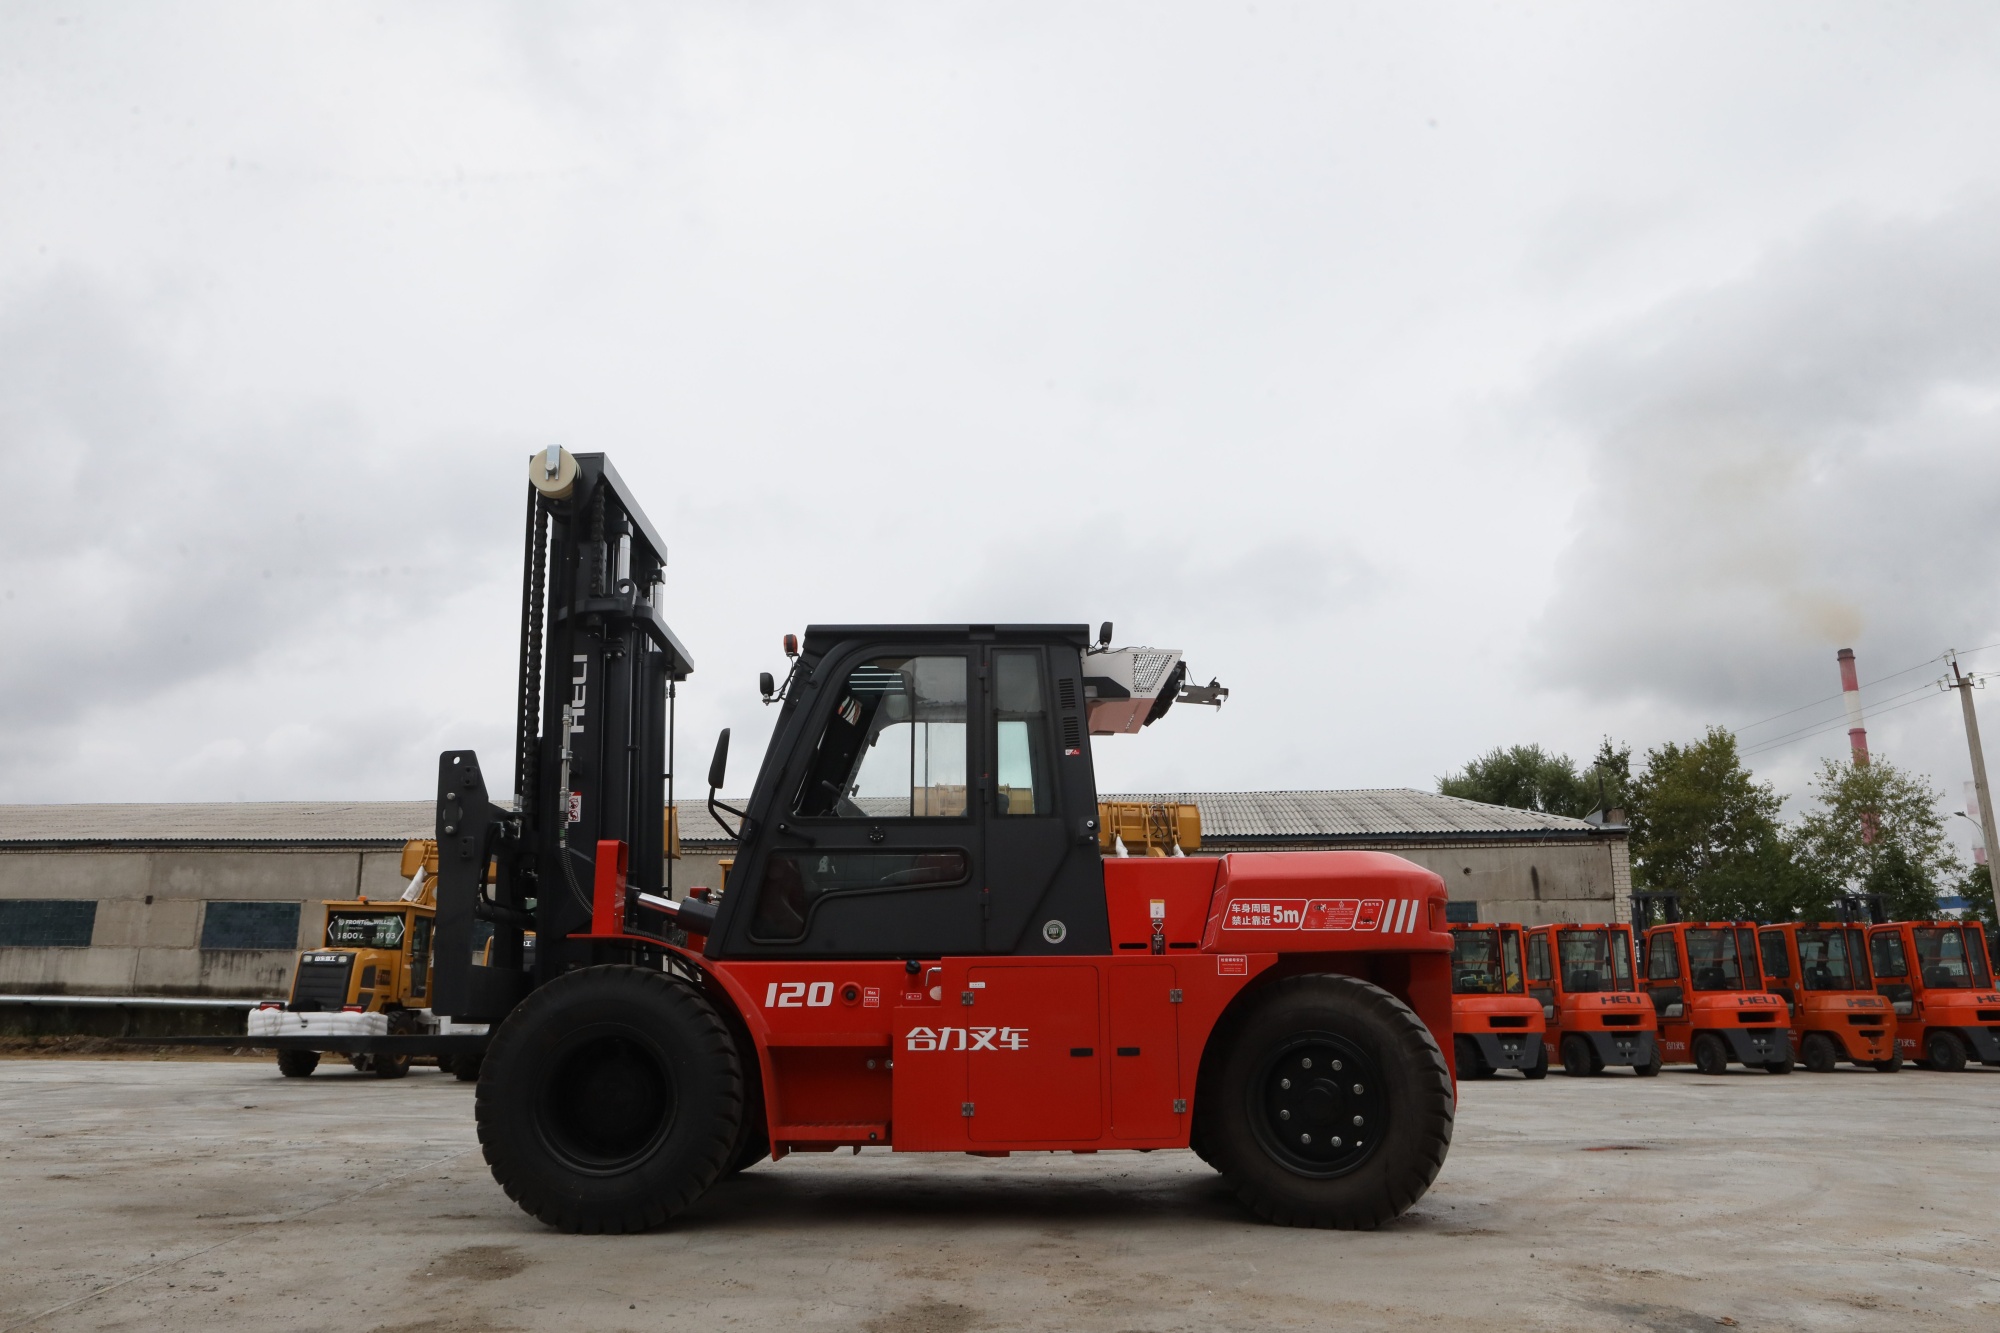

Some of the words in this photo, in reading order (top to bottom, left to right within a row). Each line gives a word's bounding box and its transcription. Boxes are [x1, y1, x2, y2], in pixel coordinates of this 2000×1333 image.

[571, 655, 588, 733] HELI
[1231, 903, 1270, 913] 车身周围
[1273, 905, 1299, 923] 5m
[1231, 916, 1271, 926] 禁止靠近
[764, 981, 835, 1008] 120
[1601, 995, 1641, 1005] HELI
[1738, 996, 1778, 1005] HELI
[1847, 998, 1884, 1007] HELI
[905, 1026, 1029, 1052] 合力叉车
